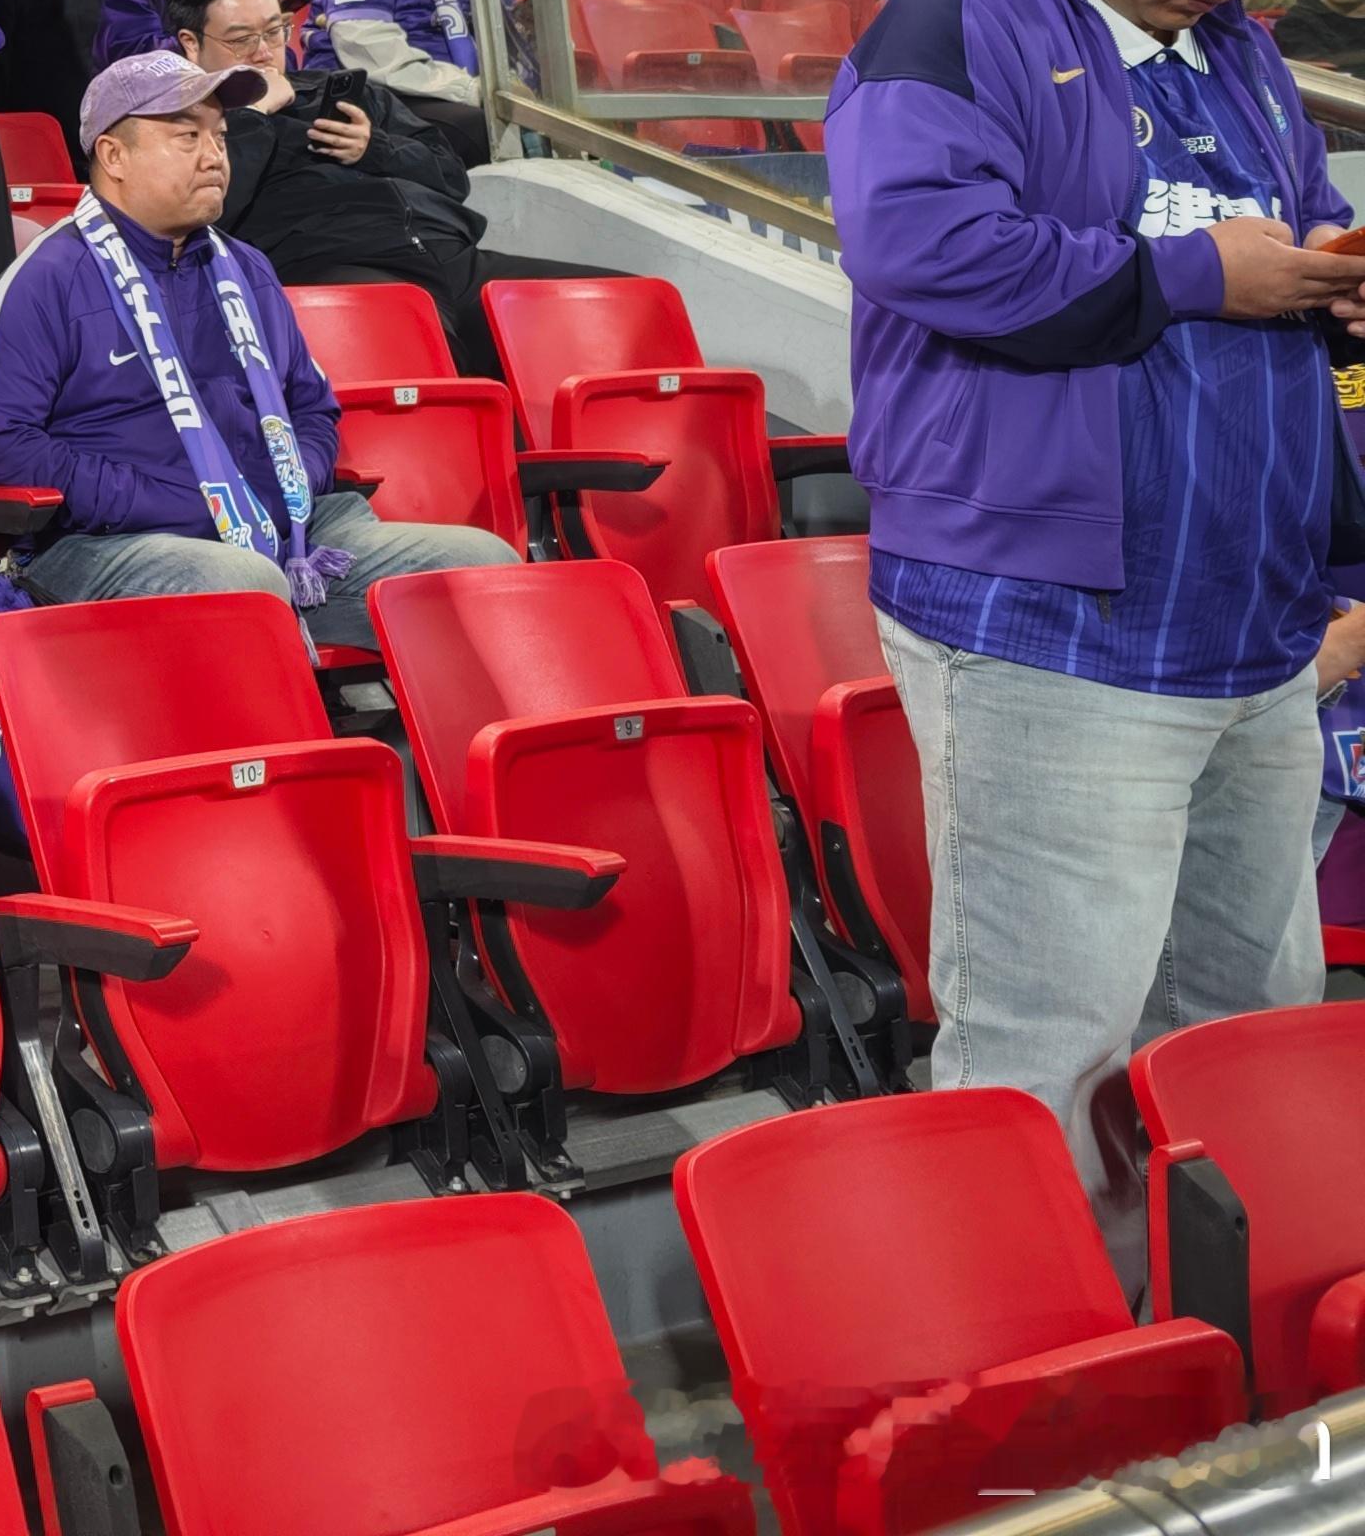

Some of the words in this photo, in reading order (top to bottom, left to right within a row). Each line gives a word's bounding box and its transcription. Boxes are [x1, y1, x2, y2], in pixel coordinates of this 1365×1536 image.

[1187, 144, 1218, 155] 956
[625, 719, 633, 736] 9
[240, 765, 257, 784] 10
